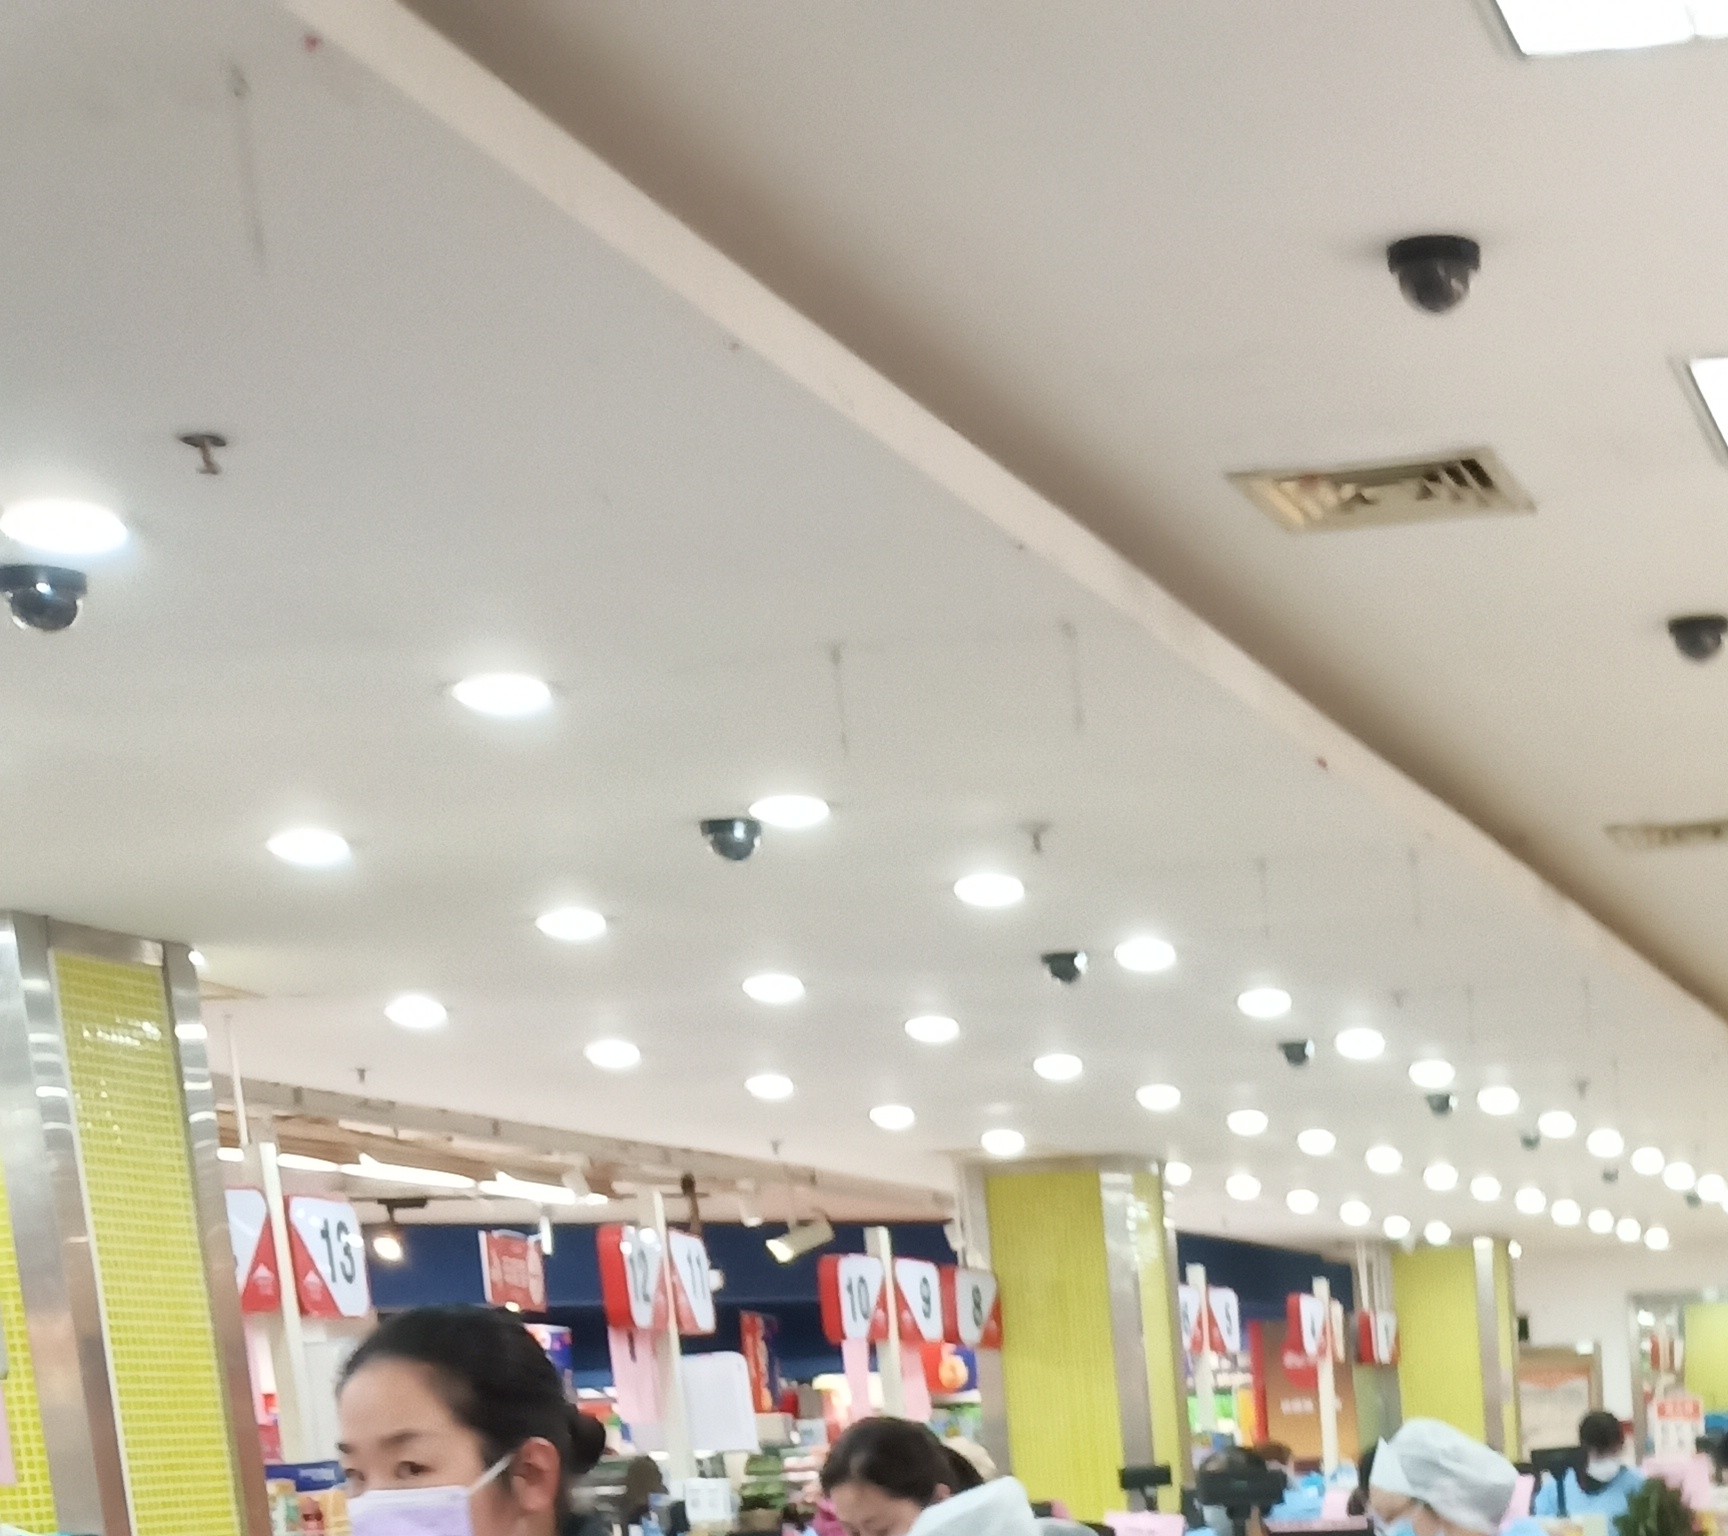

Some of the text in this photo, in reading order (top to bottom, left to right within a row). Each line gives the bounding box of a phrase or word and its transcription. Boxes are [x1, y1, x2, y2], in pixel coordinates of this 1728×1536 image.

[320, 1216, 355, 1284] 13
[847, 1275, 871, 1323] 10
[919, 1276, 931, 1319] 9
